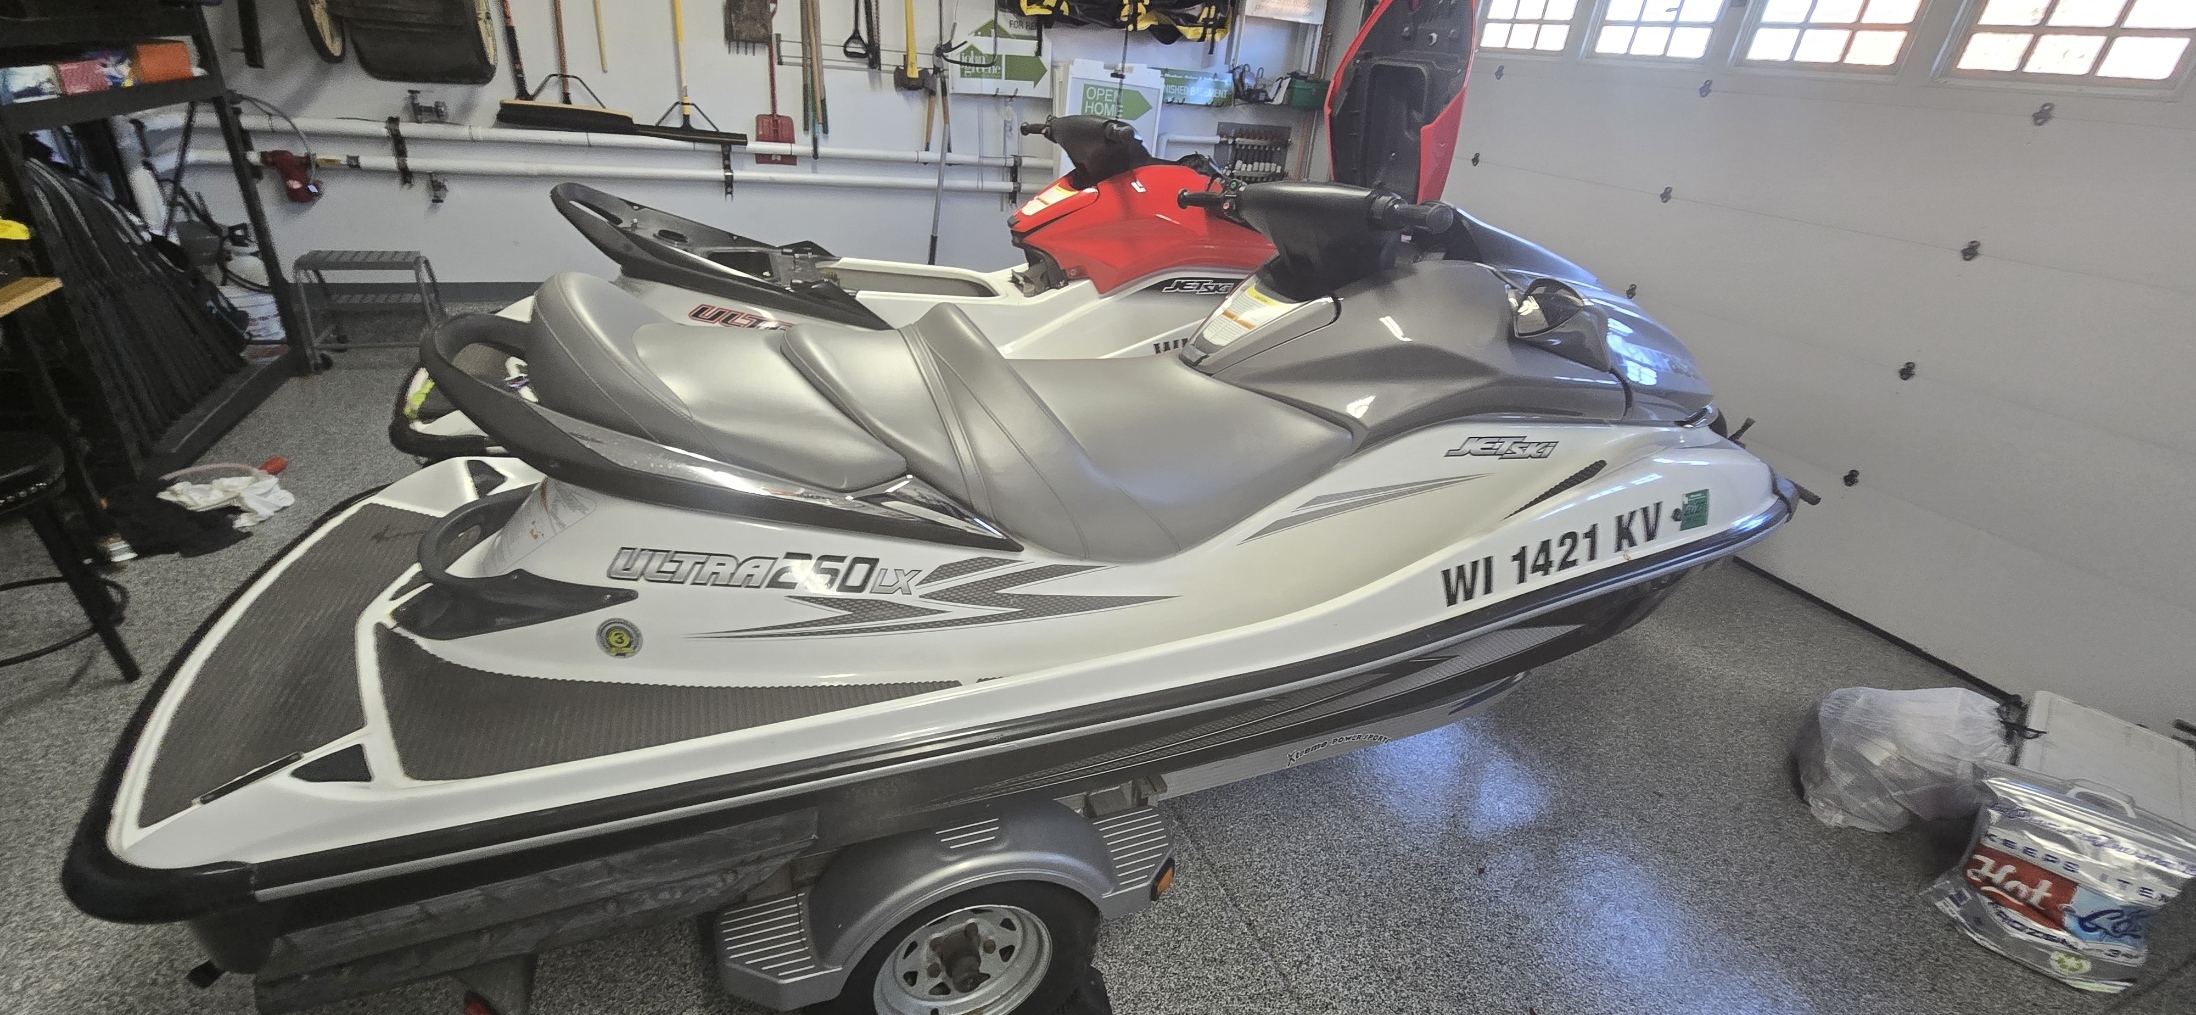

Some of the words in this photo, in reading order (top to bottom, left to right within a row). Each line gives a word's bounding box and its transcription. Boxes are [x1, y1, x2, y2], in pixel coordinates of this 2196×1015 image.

[1009, 20, 1025, 30] FOR
[1025, 21, 1038, 31] RE
[1086, 86, 1124, 102] OPEN
[1163, 84, 1189, 96] NISHED
[1084, 102, 1124, 118] HOME
[1441, 555, 1494, 608] WI
[1511, 523, 1598, 584] 1421
[1614, 501, 1664, 553] KV
[613, 632, 625, 645] 3
[1985, 832, 2080, 873] KEEPS
[1967, 853, 2053, 910] Hot
